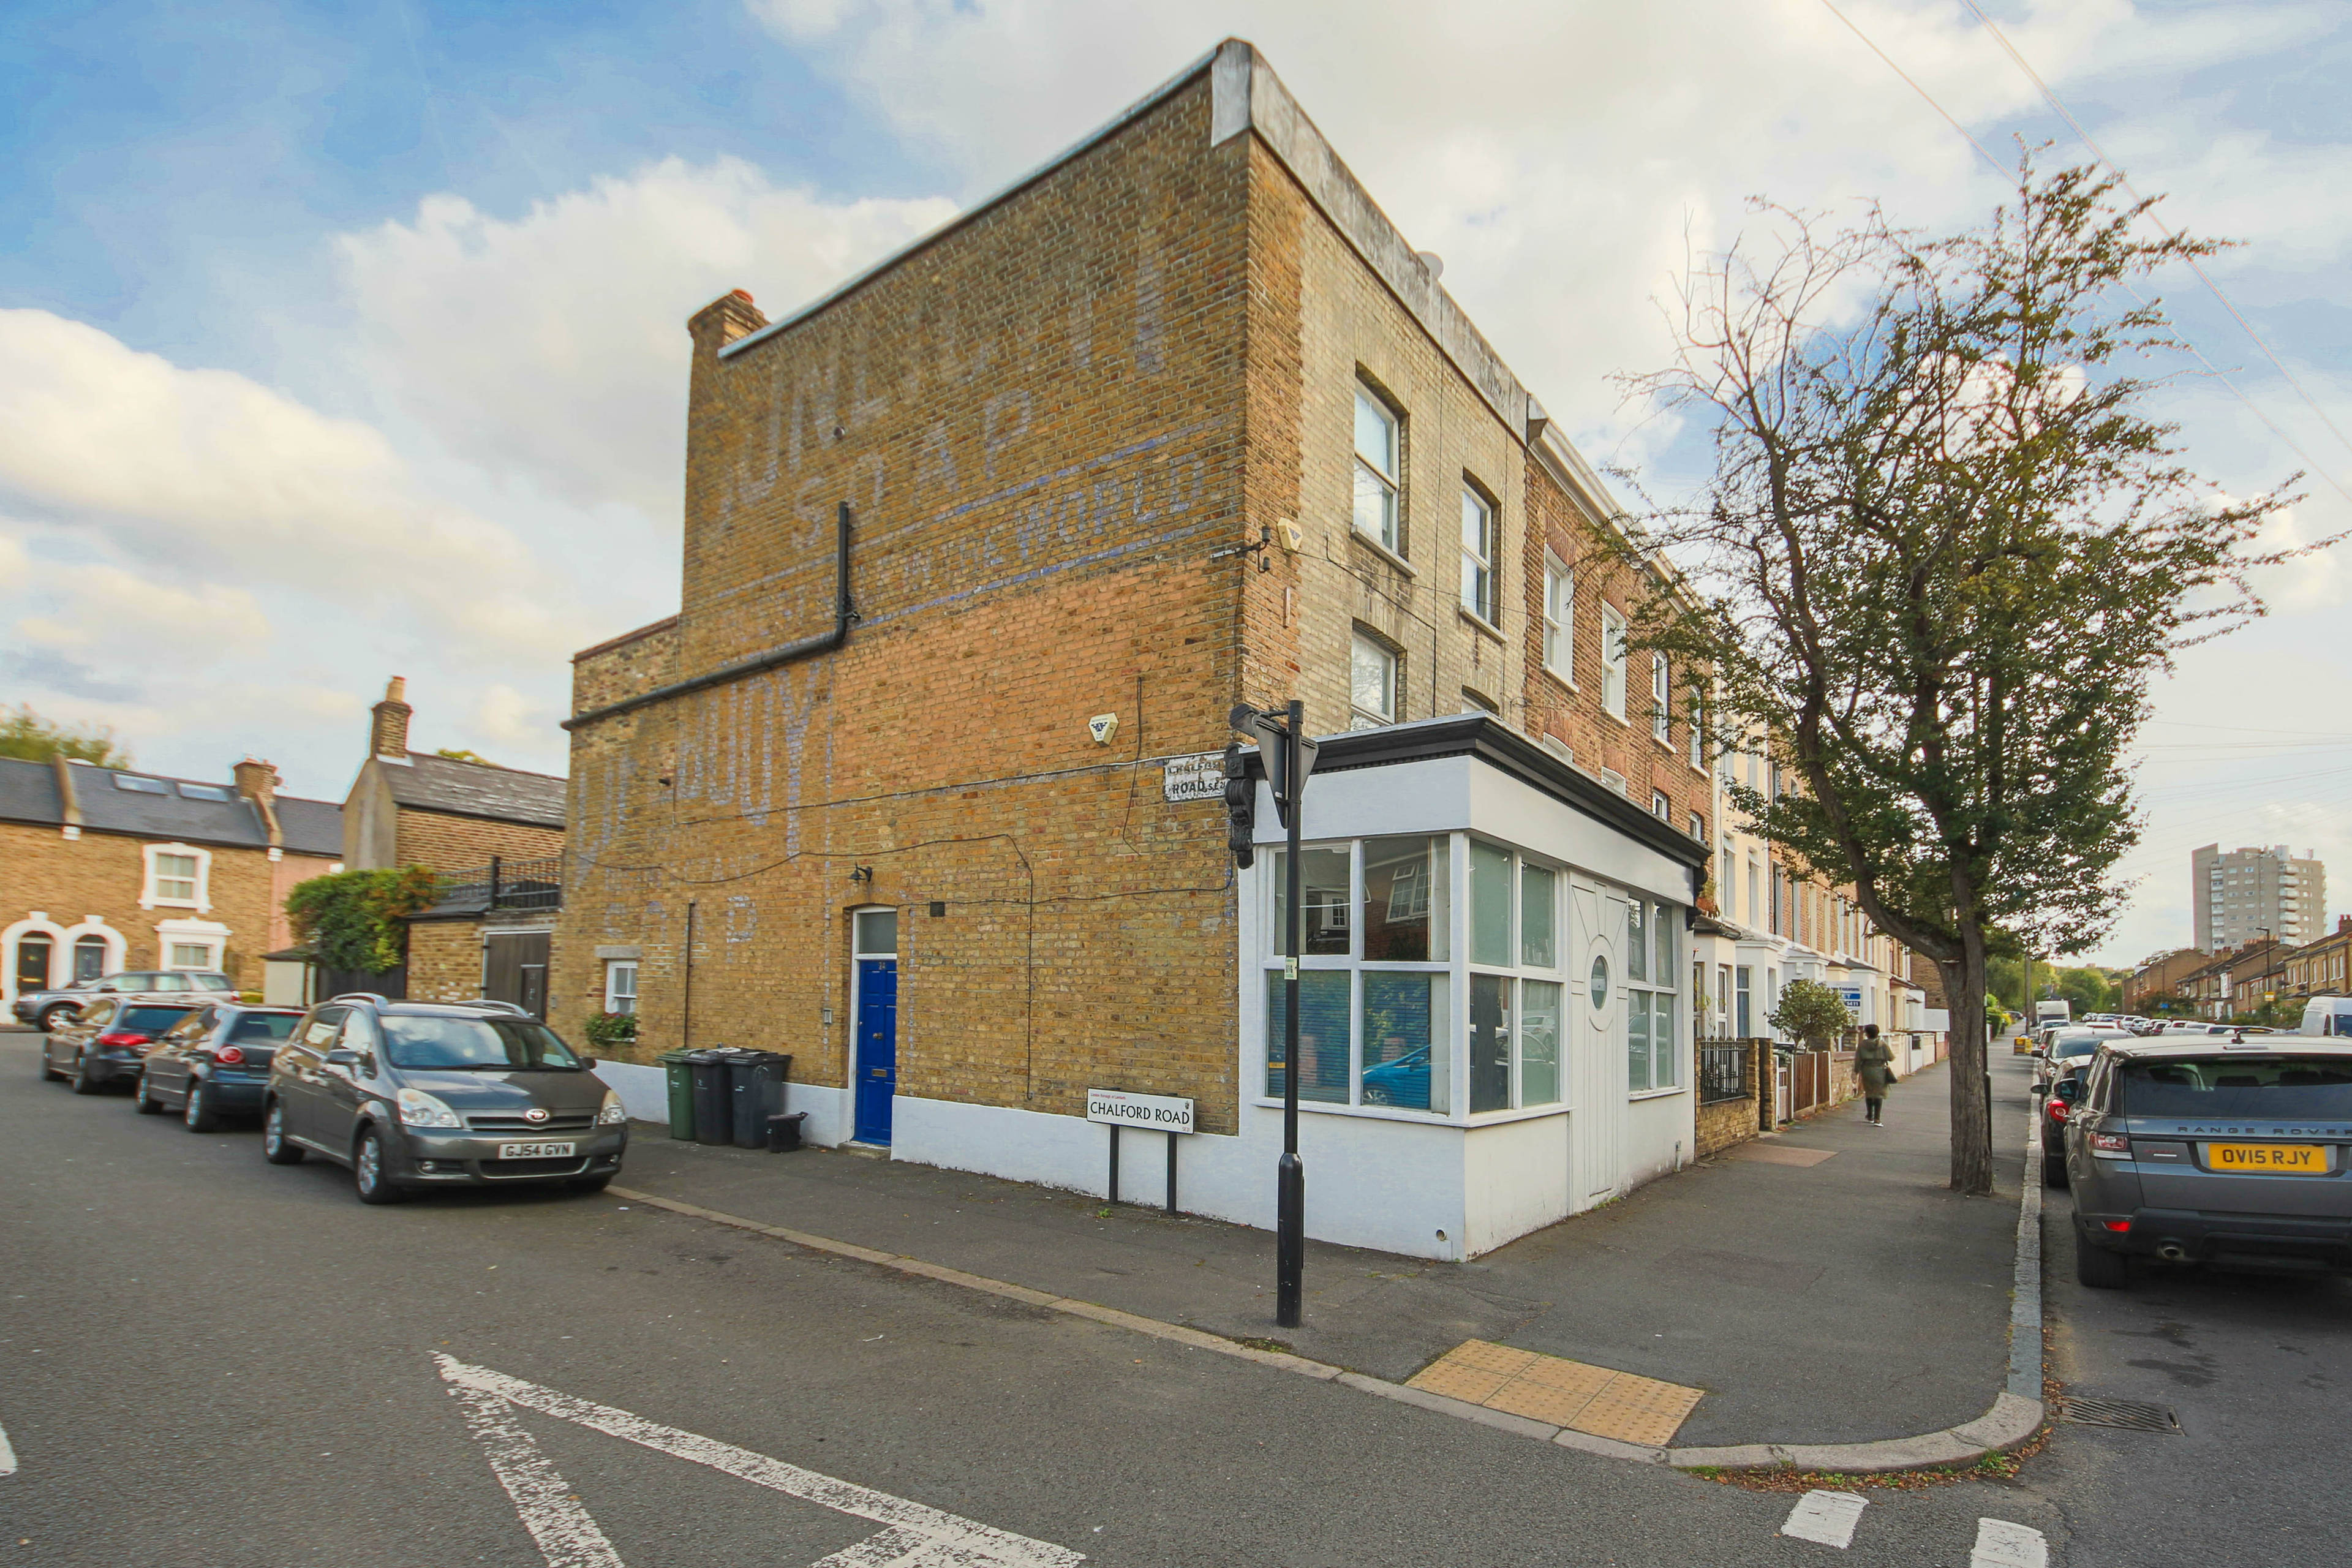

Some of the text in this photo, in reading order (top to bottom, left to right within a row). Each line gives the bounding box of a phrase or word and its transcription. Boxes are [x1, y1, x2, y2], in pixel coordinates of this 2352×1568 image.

[1172, 780, 1206, 794] ROAD
[1090, 1102, 1189, 1125] CHALFORD ROAD
[506, 1144, 570, 1156] GJ54 GVN
[2222, 1149, 2312, 1165] OV15 RJY
